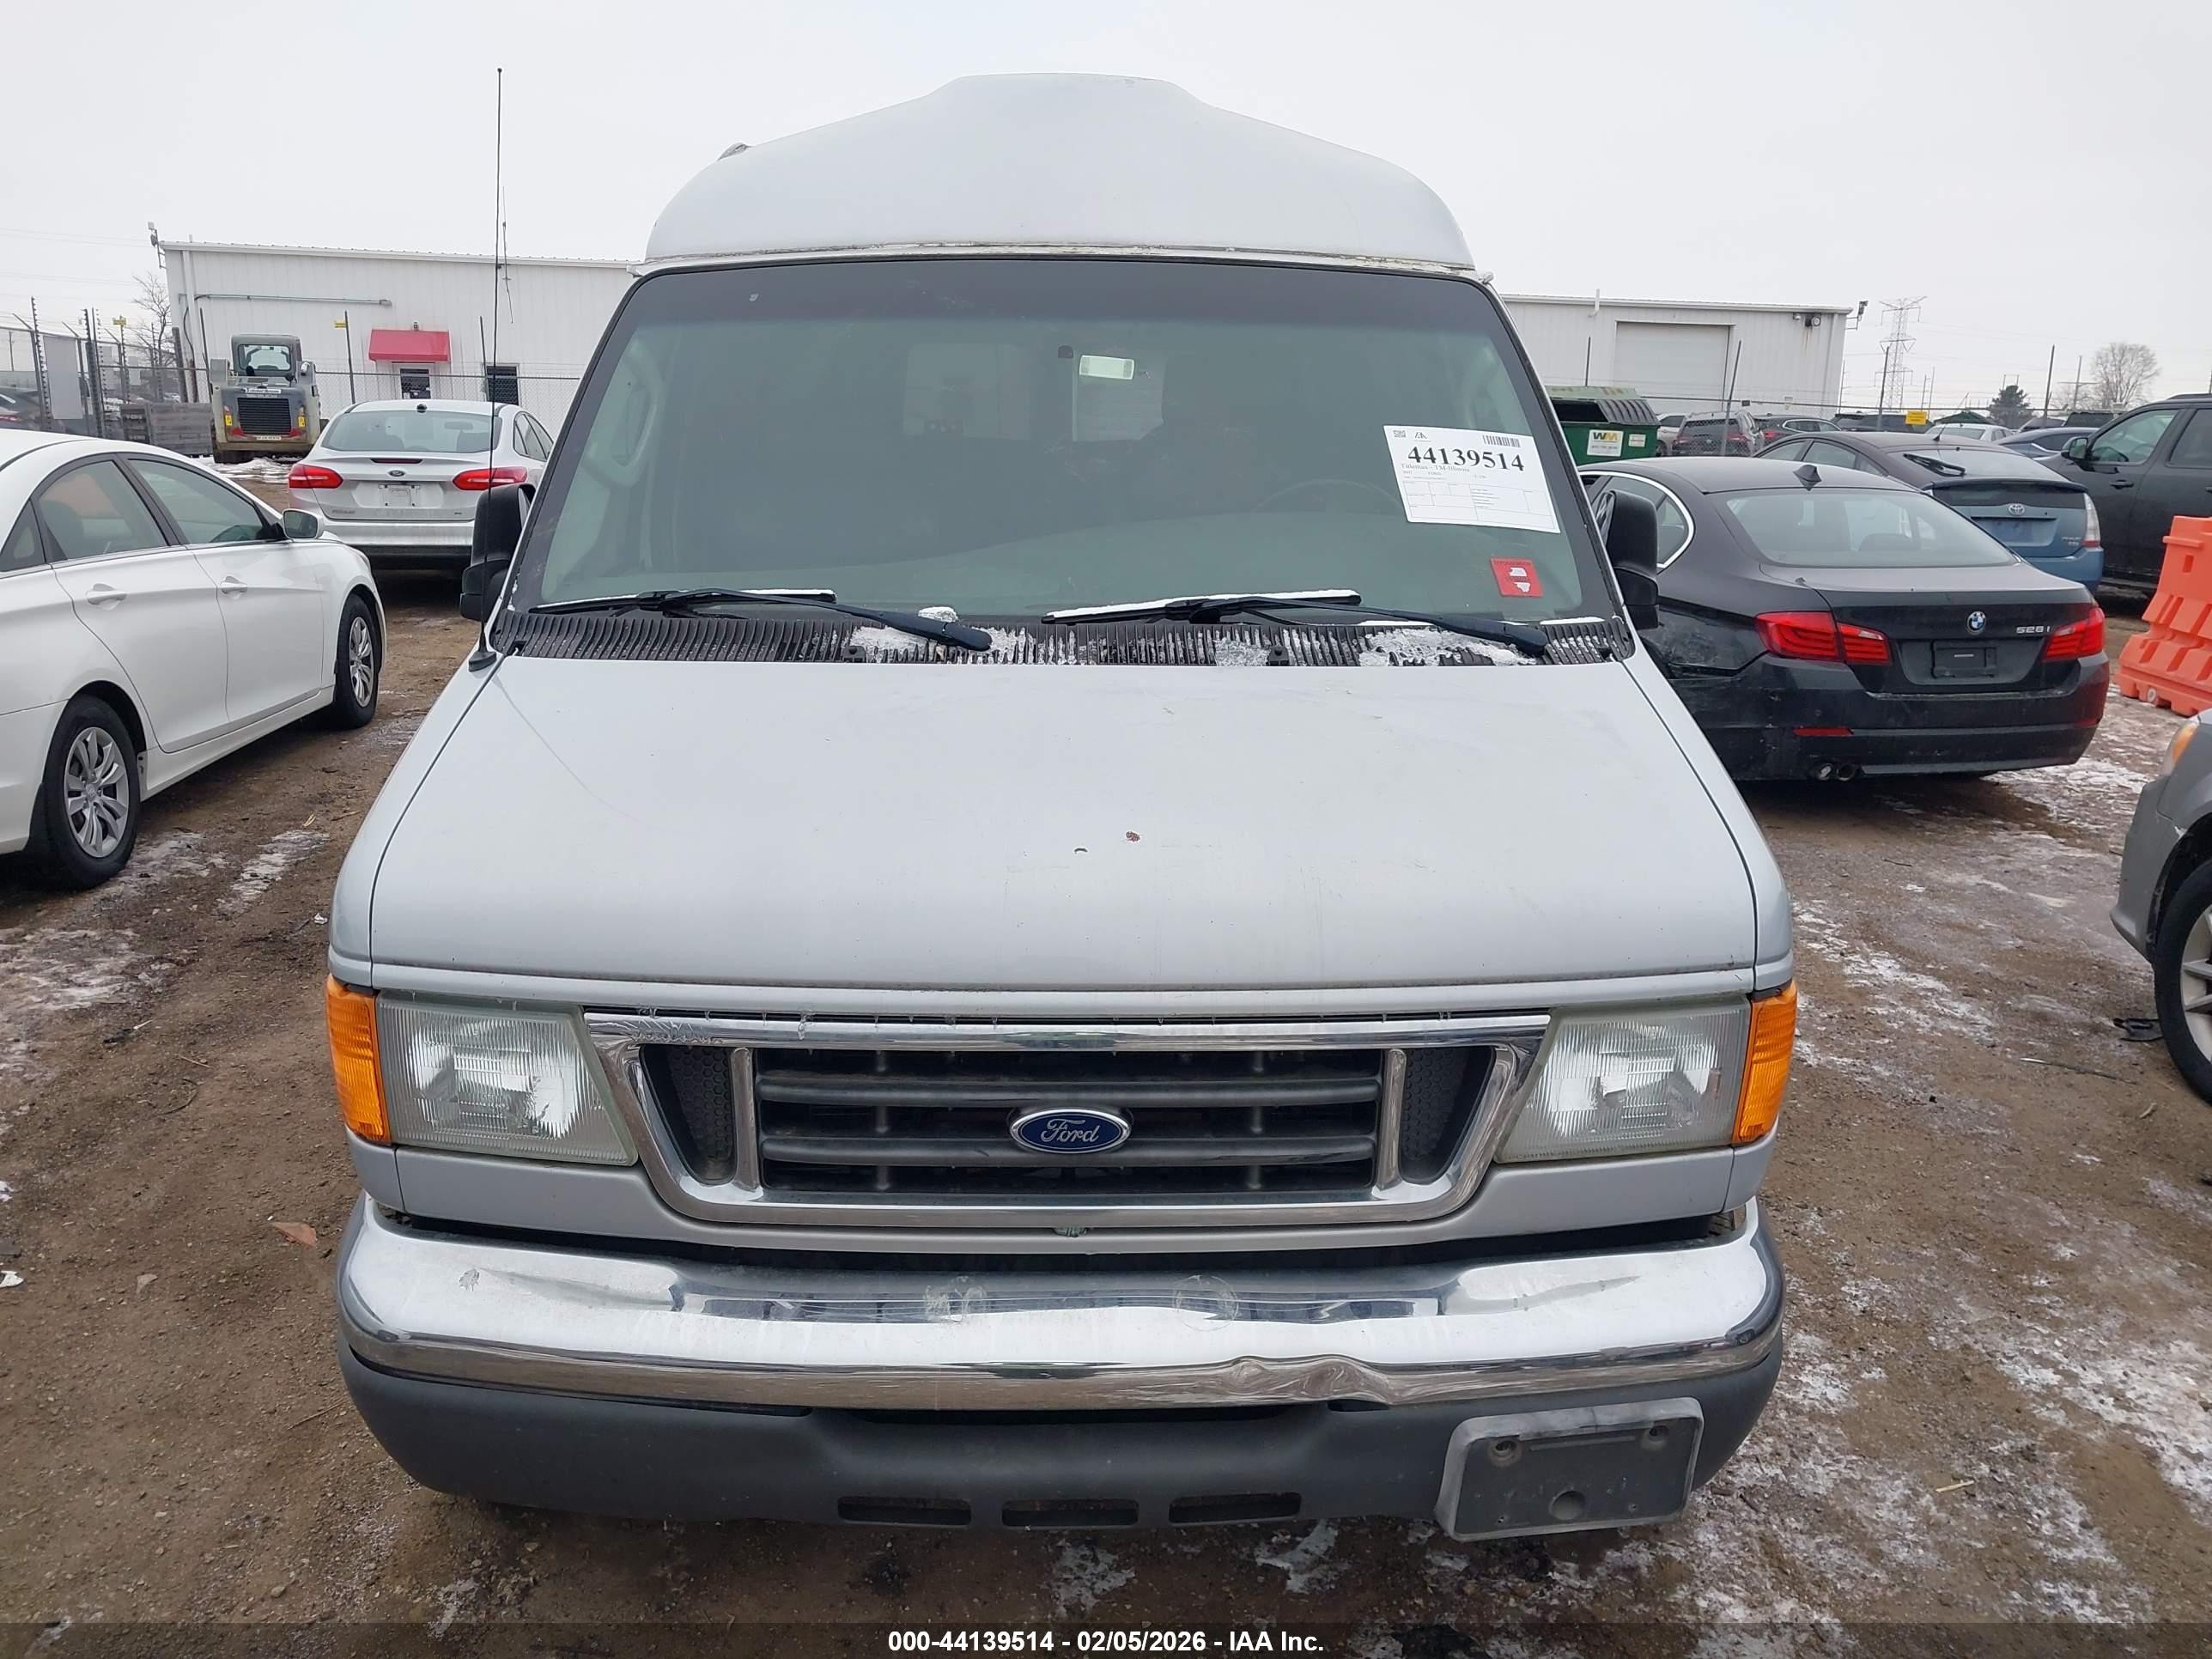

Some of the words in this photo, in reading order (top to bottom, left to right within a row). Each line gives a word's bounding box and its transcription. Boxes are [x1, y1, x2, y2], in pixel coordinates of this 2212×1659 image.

[1593, 432, 1618, 441] WM
[1407, 446, 1525, 471] 44139514
[1041, 1118, 1100, 1143] Ford
